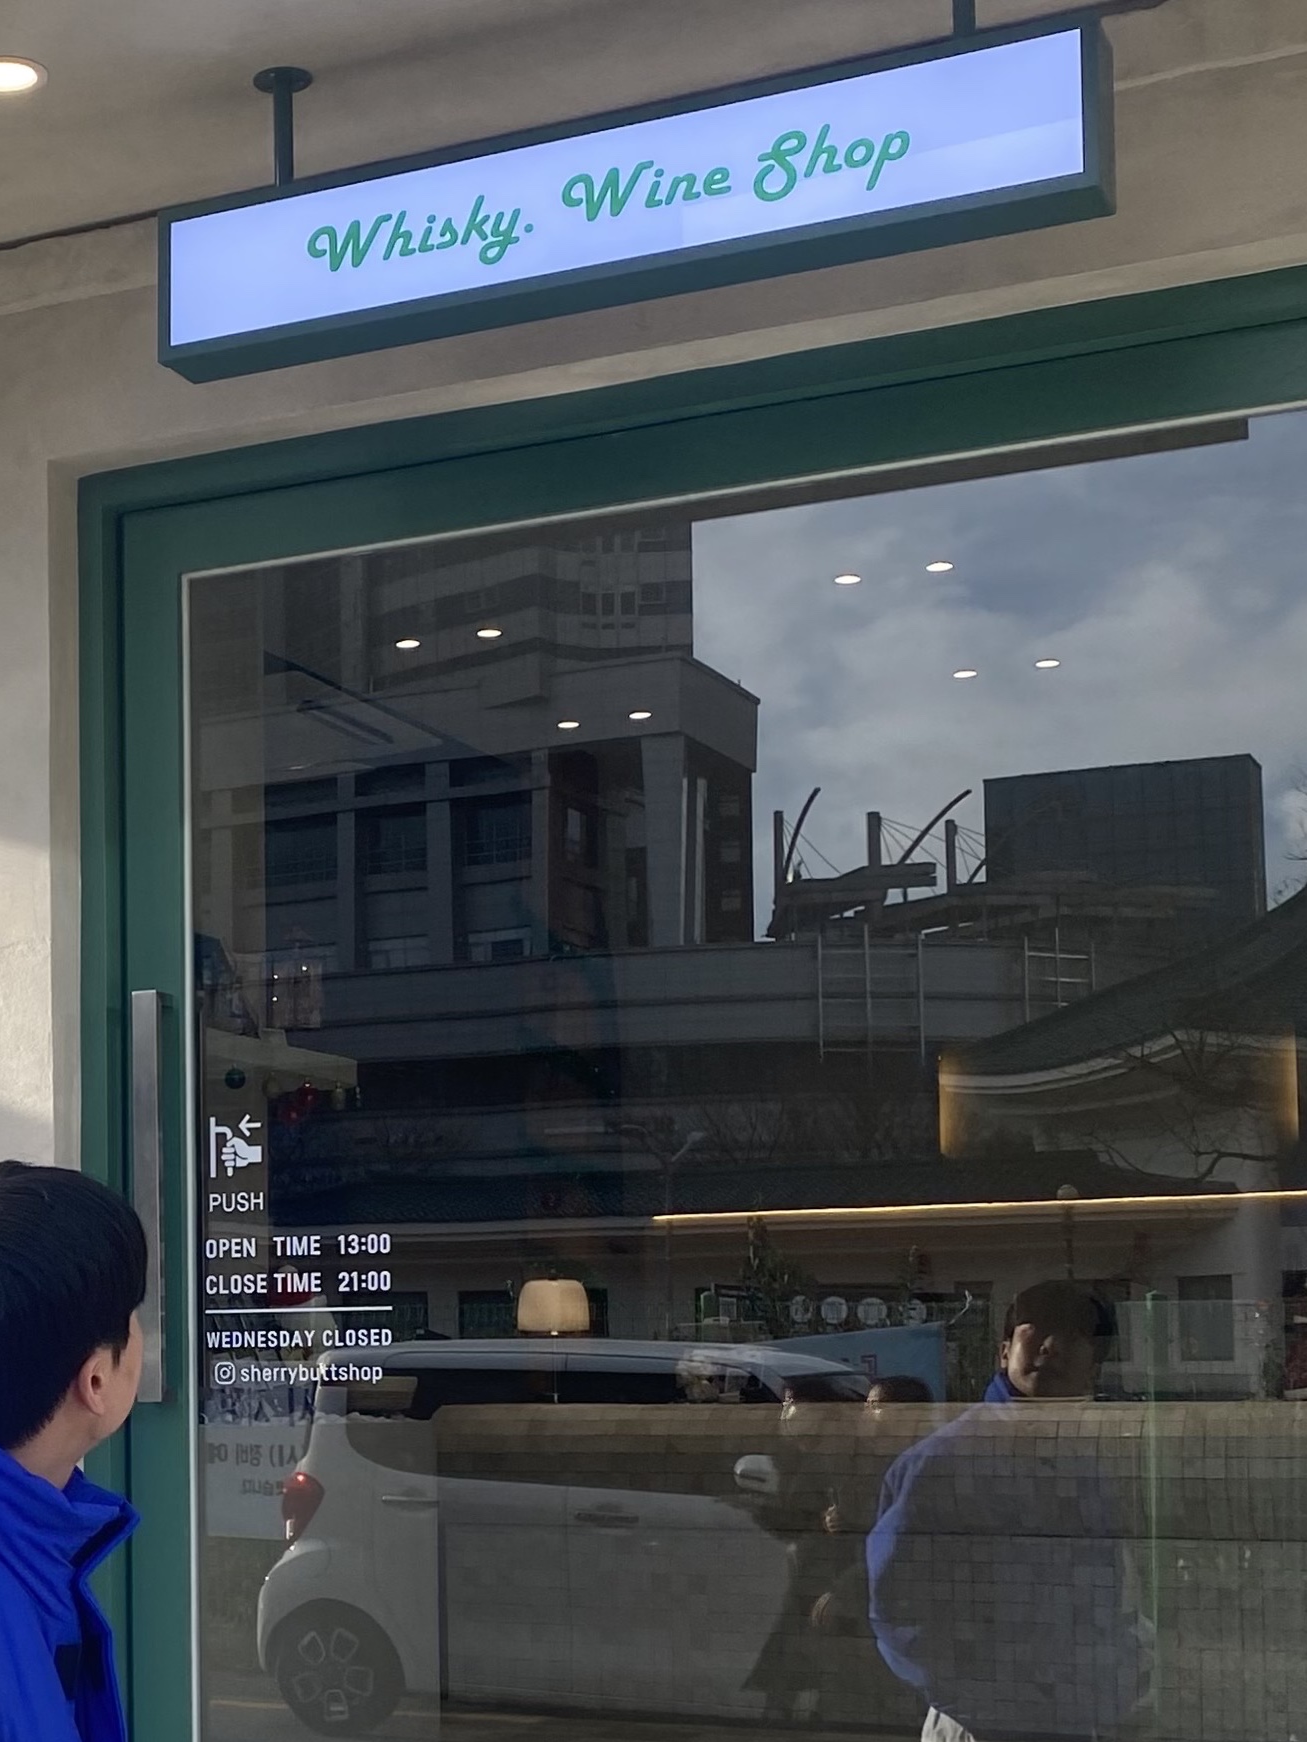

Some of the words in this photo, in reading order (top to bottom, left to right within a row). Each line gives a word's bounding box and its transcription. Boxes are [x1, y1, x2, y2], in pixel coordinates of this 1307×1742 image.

[307, 195, 534, 272] Whisky.
[561, 160, 731, 221] Wine
[753, 124, 910, 202] Shop
[208, 1192, 264, 1212] PUSH
[205, 1237, 256, 1258] OPEN
[273, 1235, 321, 1257] TIME
[337, 1233, 392, 1255] 13:00
[205, 1273, 268, 1295] CLOSE
[273, 1272, 322, 1293] TIME
[338, 1270, 392, 1292] 21:00
[206, 1329, 315, 1349] WEDNESDAY
[322, 1328, 392, 1347] CLOSED
[240, 1362, 383, 1385] sherrybuttshop
